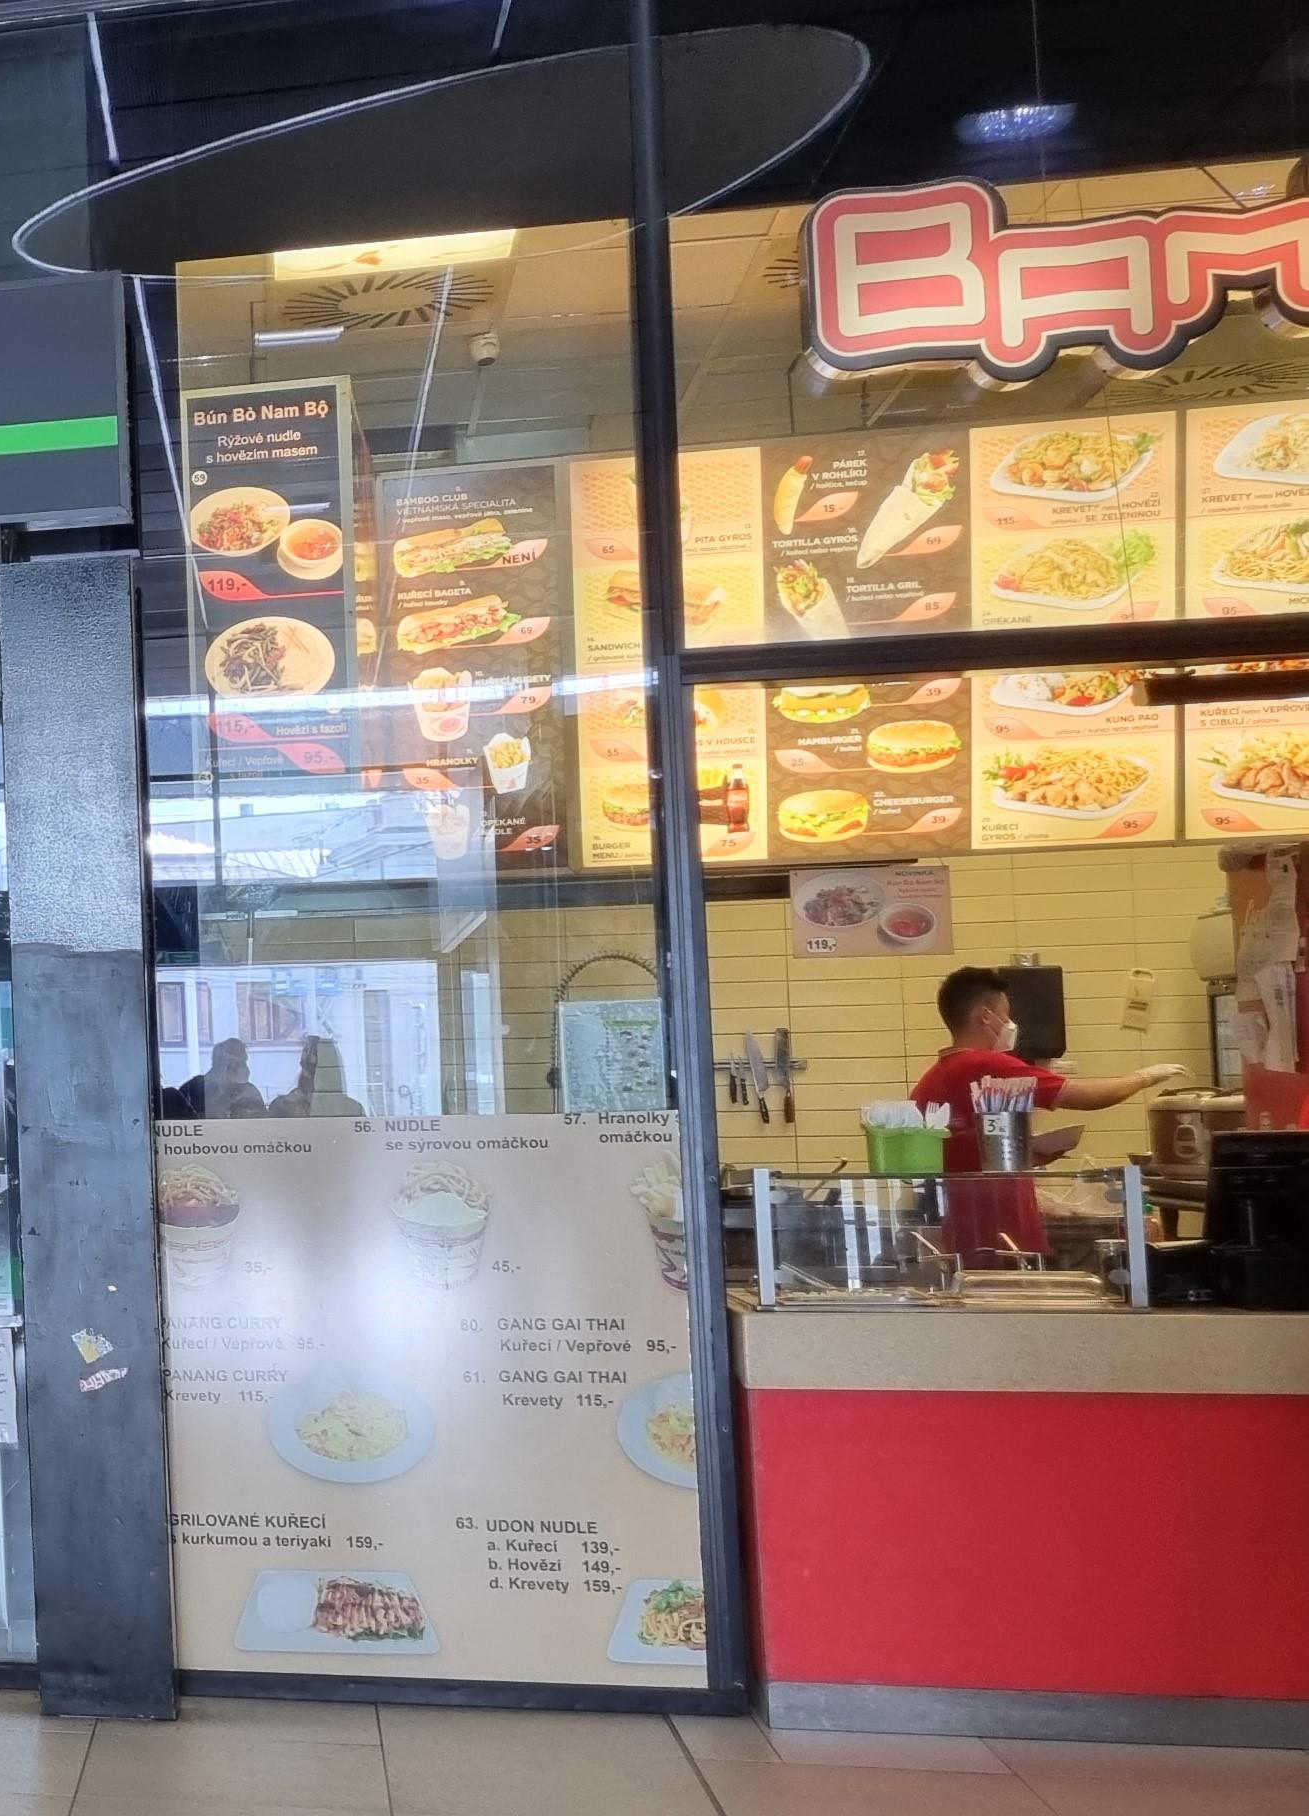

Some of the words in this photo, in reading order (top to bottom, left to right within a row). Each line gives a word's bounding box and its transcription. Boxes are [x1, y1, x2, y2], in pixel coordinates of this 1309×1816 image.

[194, 410, 227, 426] Bún
[232, 407, 257, 423] Bò
[261, 405, 300, 420] Nam
[304, 400, 329, 418] Bộ
[218, 434, 263, 449] Rýžové
[266, 430, 301, 443] nudle
[206, 455, 213, 464] s
[216, 449, 269, 463] hovězím
[271, 446, 318, 458] masem
[832, 459, 867, 469] PÁREK
[194, 474, 206, 482] 59
[811, 472, 819, 480] V
[821, 469, 867, 479] ROHLÍKU
[396, 496, 439, 506] BAMBOO
[442, 493, 468, 501] CLUB
[1202, 493, 1252, 503] KREVETY
[396, 502, 459, 516] VIETNAMSKÁ
[1052, 505, 1099, 514] KREVETY
[1122, 499, 1161, 508] HOVĚZÍ
[1101, 510, 1161, 521] ZELENINOU
[695, 535, 715, 544] PITA
[718, 533, 752, 542] GYROS
[772, 538, 820, 548] TORTILLA
[823, 535, 858, 545] GYROS
[502, 548, 538, 565] NENÍ
[208, 578, 247, 592] 119,-
[846, 583, 894, 593] TORTILLA
[897, 581, 921, 590] GRIL
[397, 588, 432, 600] KUŘECÍ
[434, 586, 472, 597] BAGETA
[587, 643, 641, 652] SANDWICH
[1106, 714, 1135, 723] KUNG
[1138, 713, 1159, 722] PAO
[1200, 707, 1239, 717] KUŘECÍ
[1210, 717, 1244, 726] CIBULÍ
[275, 724, 310, 736] Hovězí
[716, 736, 756, 745] HOUSCE
[798, 735, 862, 746] HAMBURGER
[426, 758, 479, 767] HRANOLKY
[873, 796, 954, 807] CHEESEBURGER
[982, 822, 1019, 832] KUŘECÍ
[982, 832, 1016, 841] GYROS
[592, 842, 631, 850] BURGER
[592, 851, 619, 859] MENU
[807, 939, 837, 951] 119,-
[564, 1113, 586, 1125] 57.
[599, 1111, 670, 1126] Hranolky
[354, 1120, 376, 1133] 56.
[385, 1119, 441, 1132] NUDLE
[599, 1130, 673, 1143] omáčkou
[164, 1142, 239, 1155] houbovou
[243, 1141, 312, 1154] omáčkou
[386, 1140, 403, 1150] se
[409, 1138, 471, 1152] sýrovou
[476, 1137, 549, 1149] omáčkou
[245, 1261, 273, 1275] 35,-
[492, 1261, 521, 1274] 45,-
[227, 1316, 282, 1329] CURRY
[460, 1319, 482, 1332] 60.
[497, 1318, 546, 1330] GANG
[551, 1318, 581, 1331] GAI
[586, 1318, 625, 1331] THAI
[221, 1337, 283, 1352] Vepřové
[500, 1338, 552, 1351] Kuřecí
[565, 1339, 632, 1354] Vepřové
[645, 1339, 677, 1354] 95,-
[232, 1368, 288, 1382] CURRY
[463, 1371, 486, 1383] 61.
[498, 1370, 548, 1382] GANG
[553, 1370, 582, 1383] GAI
[588, 1371, 627, 1383] THAI
[238, 1390, 274, 1403] 115,-
[502, 1394, 563, 1409] Krevety
[576, 1394, 614, 1408] 115,-
[171, 1512, 260, 1527] GRILOVANÉ
[265, 1513, 326, 1529] KUŘECÍ
[456, 1516, 478, 1530] 63.
[486, 1519, 534, 1532] UDON
[540, 1520, 599, 1534] NUDLE
[182, 1532, 258, 1546] kurkumou
[262, 1537, 271, 1546] a
[275, 1535, 331, 1550] teriyaki
[346, 1536, 384, 1550] 159,-
[487, 1541, 500, 1551] a.
[506, 1539, 558, 1553] Kuřecí
[581, 1541, 621, 1556] 139,-
[488, 1557, 502, 1570] b.
[508, 1558, 562, 1571] Hovězí
[582, 1560, 621, 1575] 149,-
[489, 1576, 503, 1589] d.
[509, 1577, 569, 1594] Krevety
[583, 1579, 622, 1594] 159,-
